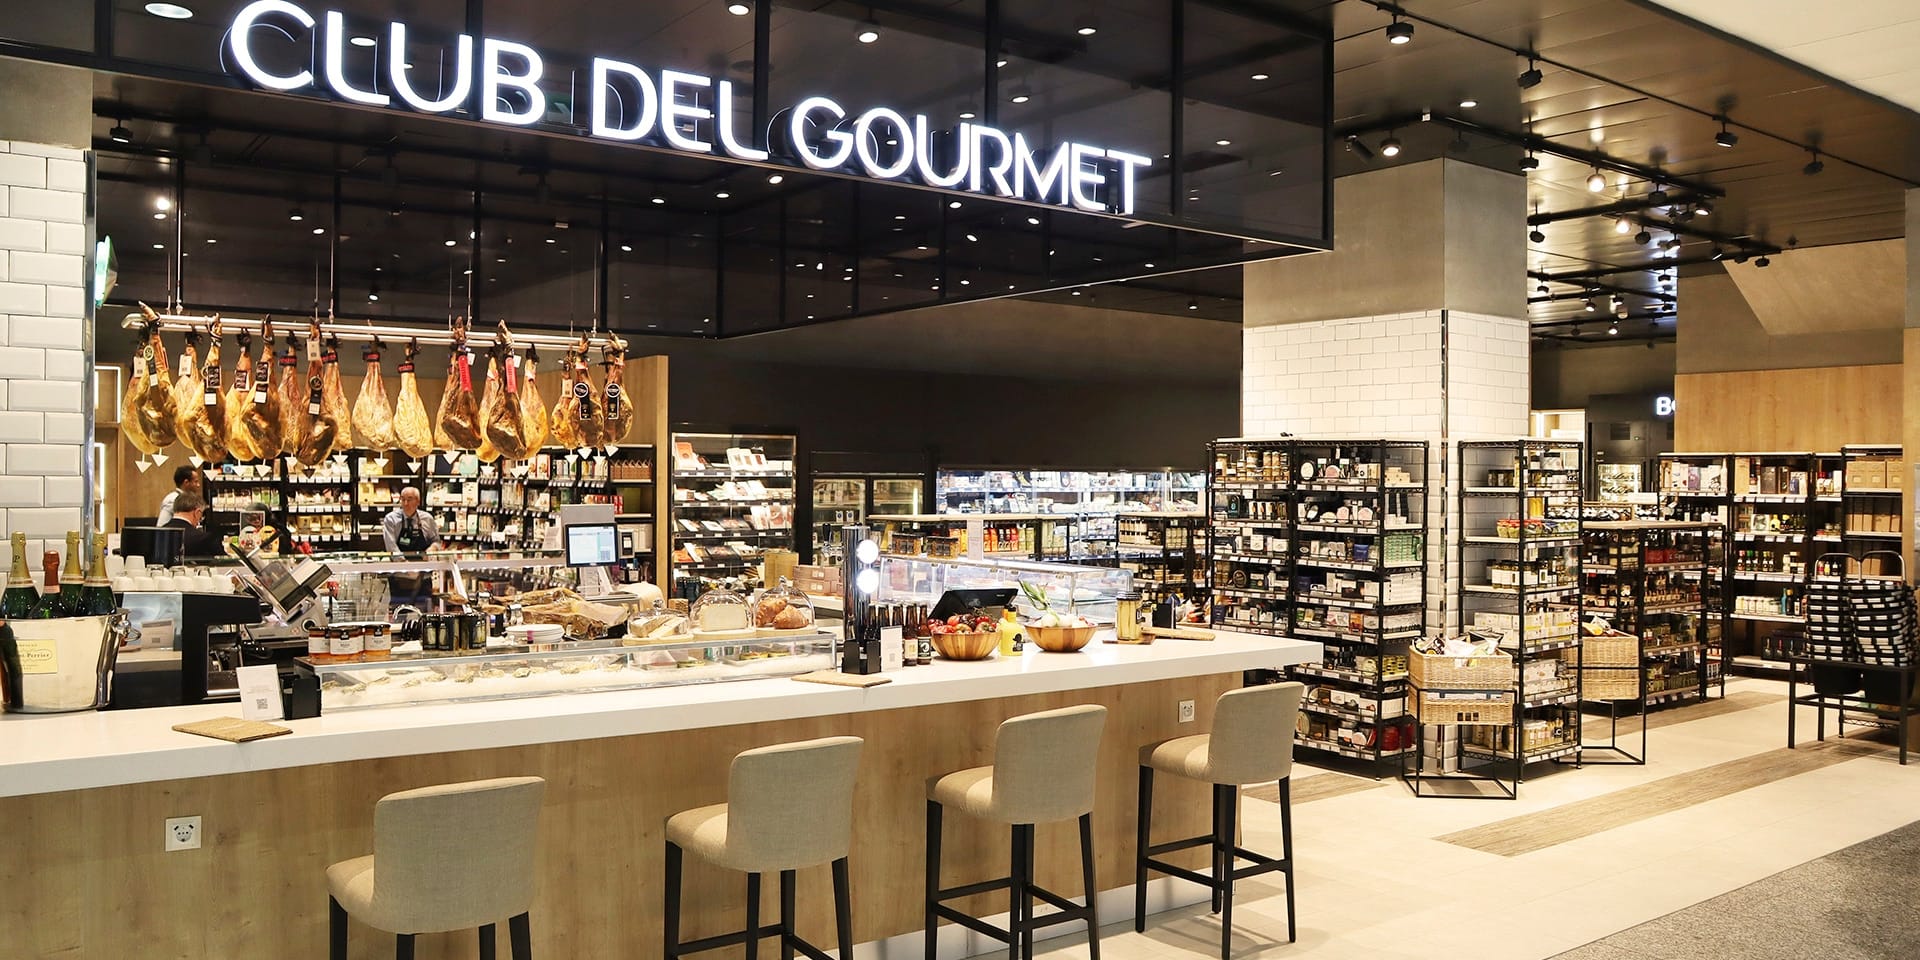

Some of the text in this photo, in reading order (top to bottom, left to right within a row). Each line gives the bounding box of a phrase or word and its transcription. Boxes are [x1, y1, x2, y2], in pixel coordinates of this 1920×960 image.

[230, 0, 1152, 215] CLUB DEL GOURMET
